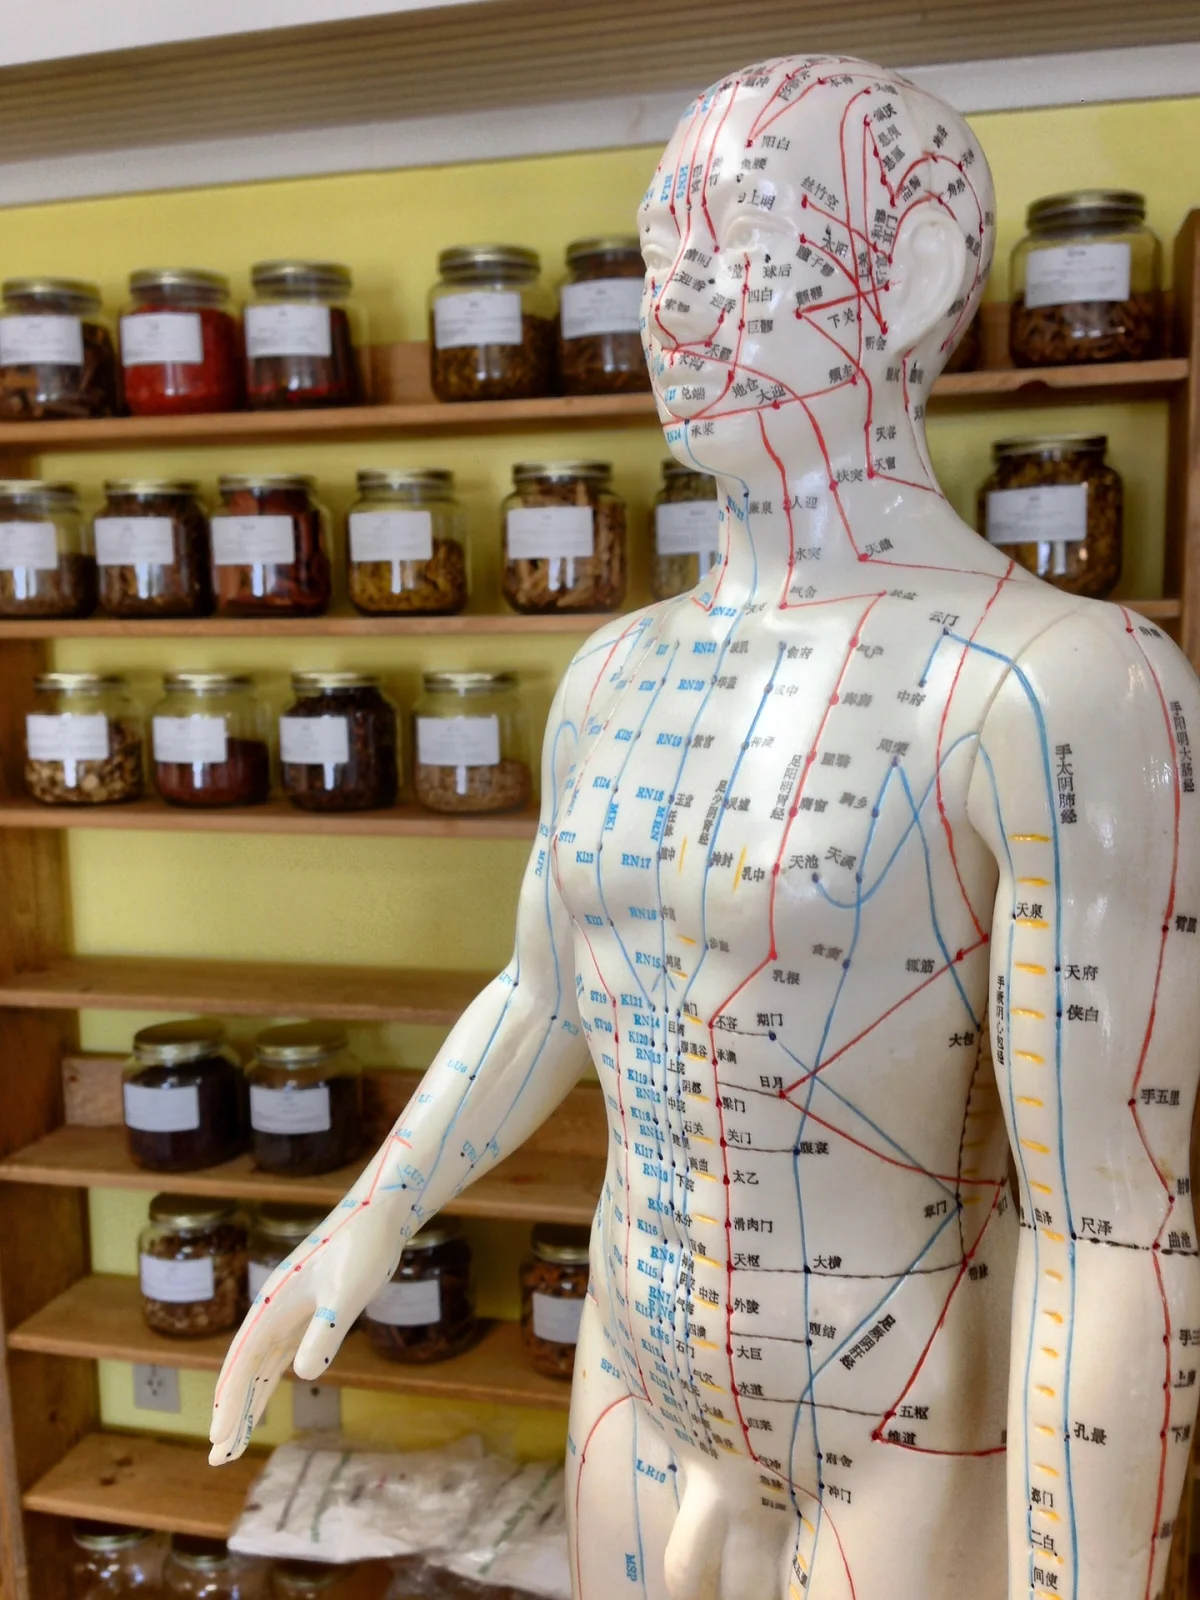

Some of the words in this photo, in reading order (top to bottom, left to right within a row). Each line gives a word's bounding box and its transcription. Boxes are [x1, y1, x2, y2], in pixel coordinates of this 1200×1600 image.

[761, 135, 790, 151] 阳白
[747, 188, 776, 211] 上明
[801, 175, 839, 211] 丝竹空
[823, 236, 850, 259] 太阳
[796, 245, 835, 277] 瞳子髎
[762, 264, 793, 279] 球后
[709, 292, 737, 313] 迎香
[748, 287, 773, 302] 四白
[747, 319, 774, 334] 巨髎
[827, 307, 855, 329] 下关
[732, 377, 759, 398] 地仓
[756, 385, 786, 404] 大迎
[690, 423, 715, 438] 承浆
[750, 501, 772, 514] 廉泉
[792, 496, 818, 510] 人迎
[795, 547, 821, 560] 水突
[865, 538, 893, 556] 天鼎
[929, 611, 960, 627] 云门
[692, 642, 717, 653] RN21
[897, 690, 926, 707] 中府
[1169, 700, 1195, 793] 手阳明大肠经
[770, 754, 802, 821] 足阳明胃经
[1055, 743, 1077, 825] 手太阴肺经
[636, 787, 665, 802] RN18
[651, 806, 665, 841] MRN
[621, 853, 652, 869] RN17
[712, 851, 734, 868] 神封
[788, 854, 819, 869] 天池
[824, 846, 857, 870] 天溪
[741, 867, 766, 882] 乳中
[629, 907, 656, 921] RN16
[1016, 902, 1043, 919] 天泉
[635, 951, 661, 968] RN15
[771, 969, 801, 986] 乳根
[1064, 964, 1099, 981] 天府
[620, 994, 643, 1008] KI21
[633, 1013, 660, 1029] RN14
[756, 1012, 784, 1027] 期门
[1066, 1004, 1099, 1022] 侠白
[715, 1015, 738, 1030] 不容
[628, 1031, 649, 1046] KI20
[949, 1031, 974, 1049] 大包
[636, 1048, 661, 1064] RN13
[627, 1068, 648, 1085] KI19
[760, 1075, 784, 1089] 日月
[636, 1087, 661, 1103] RN12
[1141, 1089, 1180, 1106] 手五里
[630, 1106, 651, 1122] KI18
[721, 1097, 746, 1114] 梁门
[684, 1120, 704, 1136] 石关
[727, 1128, 752, 1145] 关门
[634, 1143, 654, 1160] KI17
[643, 1163, 668, 1182] RN10
[733, 1170, 759, 1185] 太乙
[647, 1197, 670, 1216] RN9
[637, 1219, 658, 1236] KI16
[674, 1210, 693, 1228] 水分
[734, 1217, 773, 1234] 滑肉门
[1081, 1216, 1113, 1236] 尺泽
[1168, 1231, 1191, 1249] 曲池
[650, 1246, 675, 1264] RN8
[734, 1253, 760, 1267] 天枢
[813, 1255, 842, 1270] 大横
[637, 1259, 658, 1278] KI15
[649, 1286, 671, 1305] RN7
[699, 1286, 720, 1305] 中注
[734, 1298, 760, 1315] 外陵
[650, 1325, 670, 1345] RN5
[809, 1322, 836, 1340] 腹结
[675, 1339, 696, 1359] 石门
[737, 1345, 763, 1361] 大巨
[738, 1381, 764, 1397] 水道
[899, 1405, 930, 1421] 五枢
[887, 1429, 917, 1445] 维道
[1074, 1422, 1107, 1446] 孔最
[635, 1459, 666, 1484] LR10
[827, 1484, 852, 1505] 冲门
[1031, 1530, 1054, 1551] 二白
[625, 1552, 637, 1582] MSP
[1033, 1566, 1058, 1591] 间使
